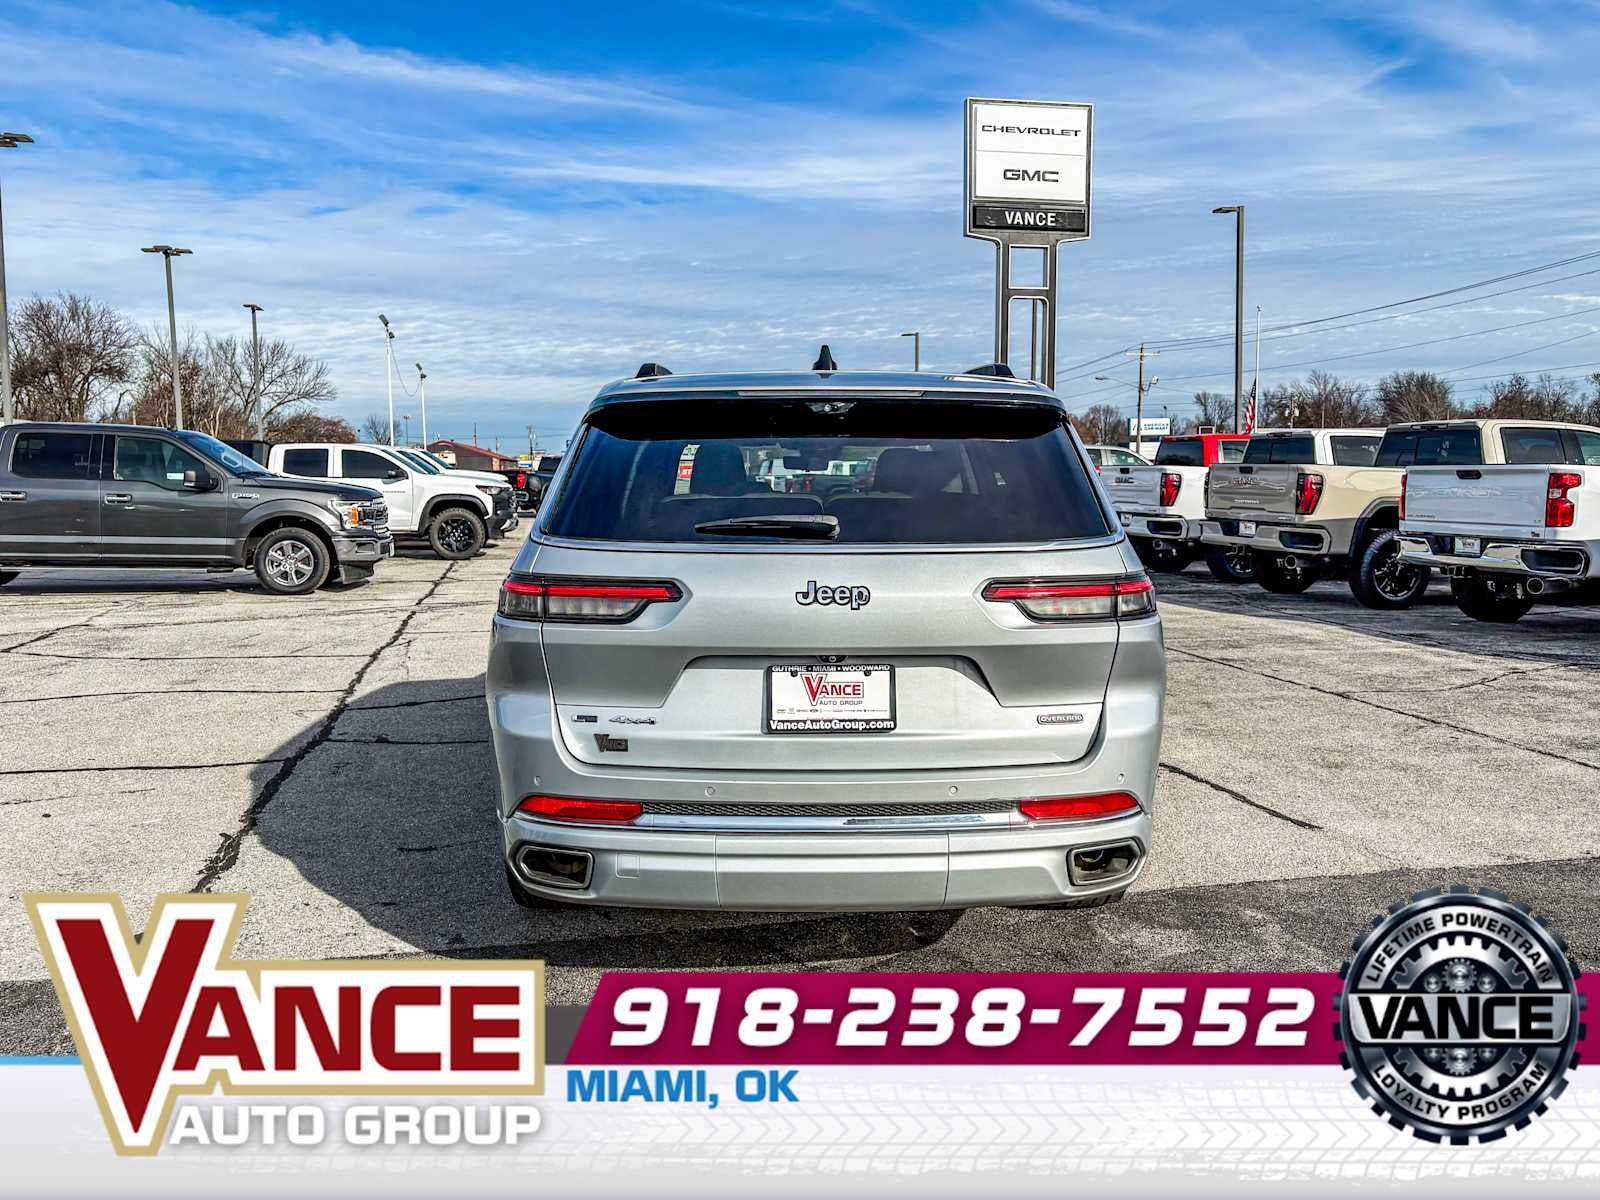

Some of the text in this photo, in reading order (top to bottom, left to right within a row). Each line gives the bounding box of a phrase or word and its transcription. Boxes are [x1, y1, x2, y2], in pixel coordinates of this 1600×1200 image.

[981, 125, 1081, 137] CHEVROLET
[1003, 169, 1059, 183] GMC
[1004, 211, 1057, 226] VANCE
[795, 580, 870, 611] Jeep
[803, 674, 862, 702] VANCE
[770, 720, 895, 731] VanceAutoGroup.com
